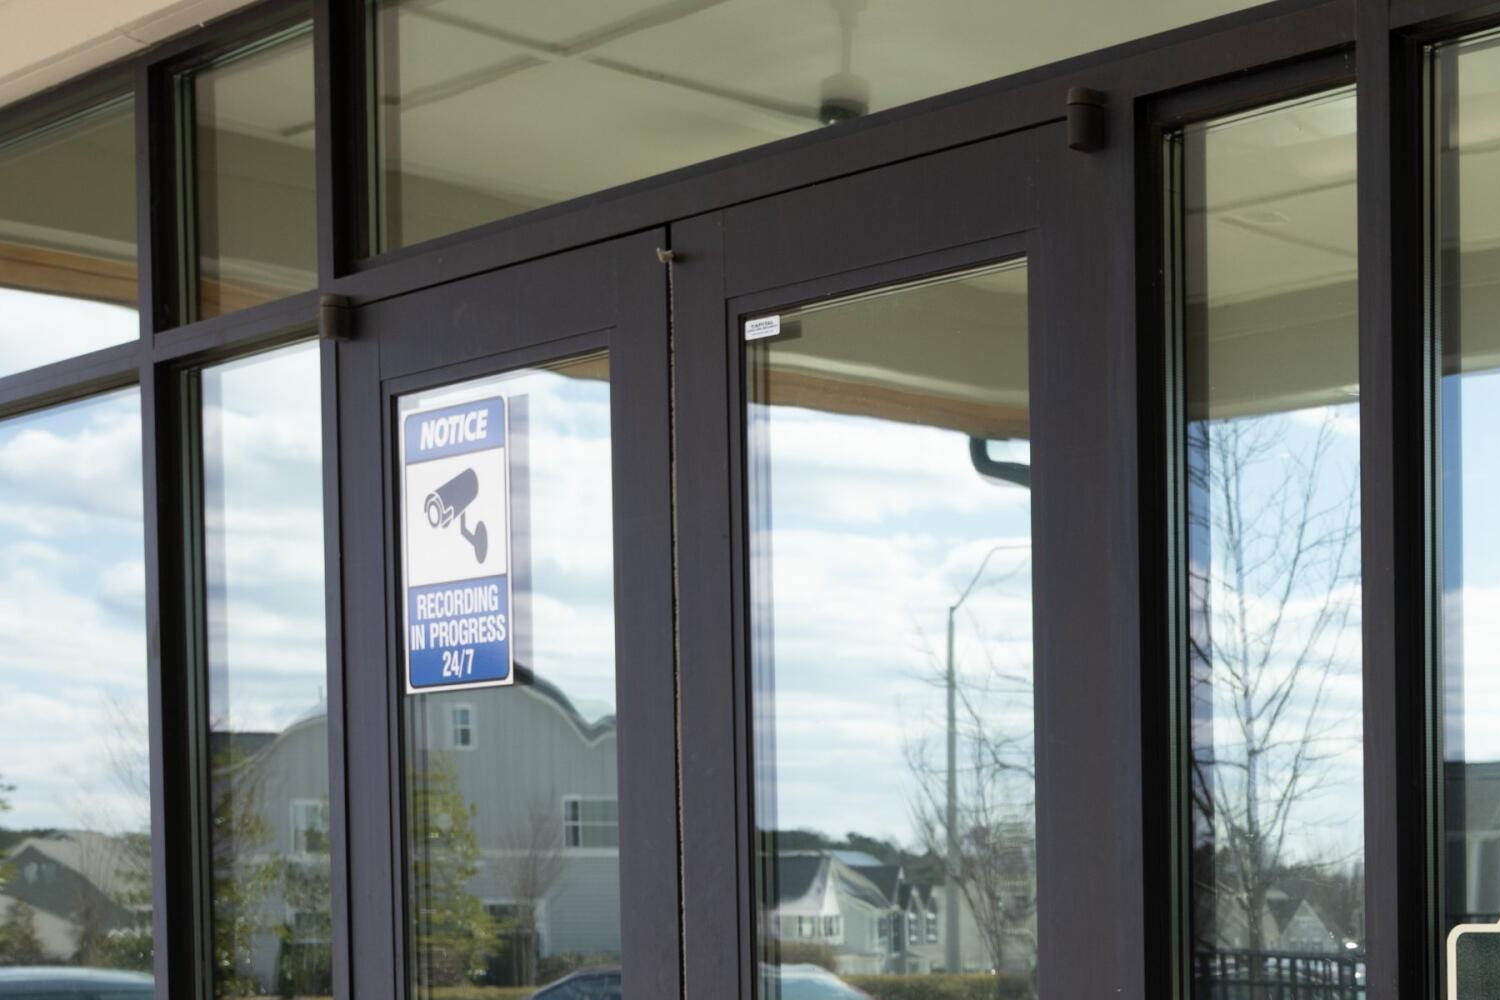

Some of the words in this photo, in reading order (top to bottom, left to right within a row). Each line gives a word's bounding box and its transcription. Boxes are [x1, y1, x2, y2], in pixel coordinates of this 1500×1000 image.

[420, 409, 489, 450] NOTICE
[416, 584, 498, 621] RECORDING
[411, 623, 426, 651] IN
[429, 614, 506, 647] PROGRESS
[442, 648, 475, 679] 24/7
